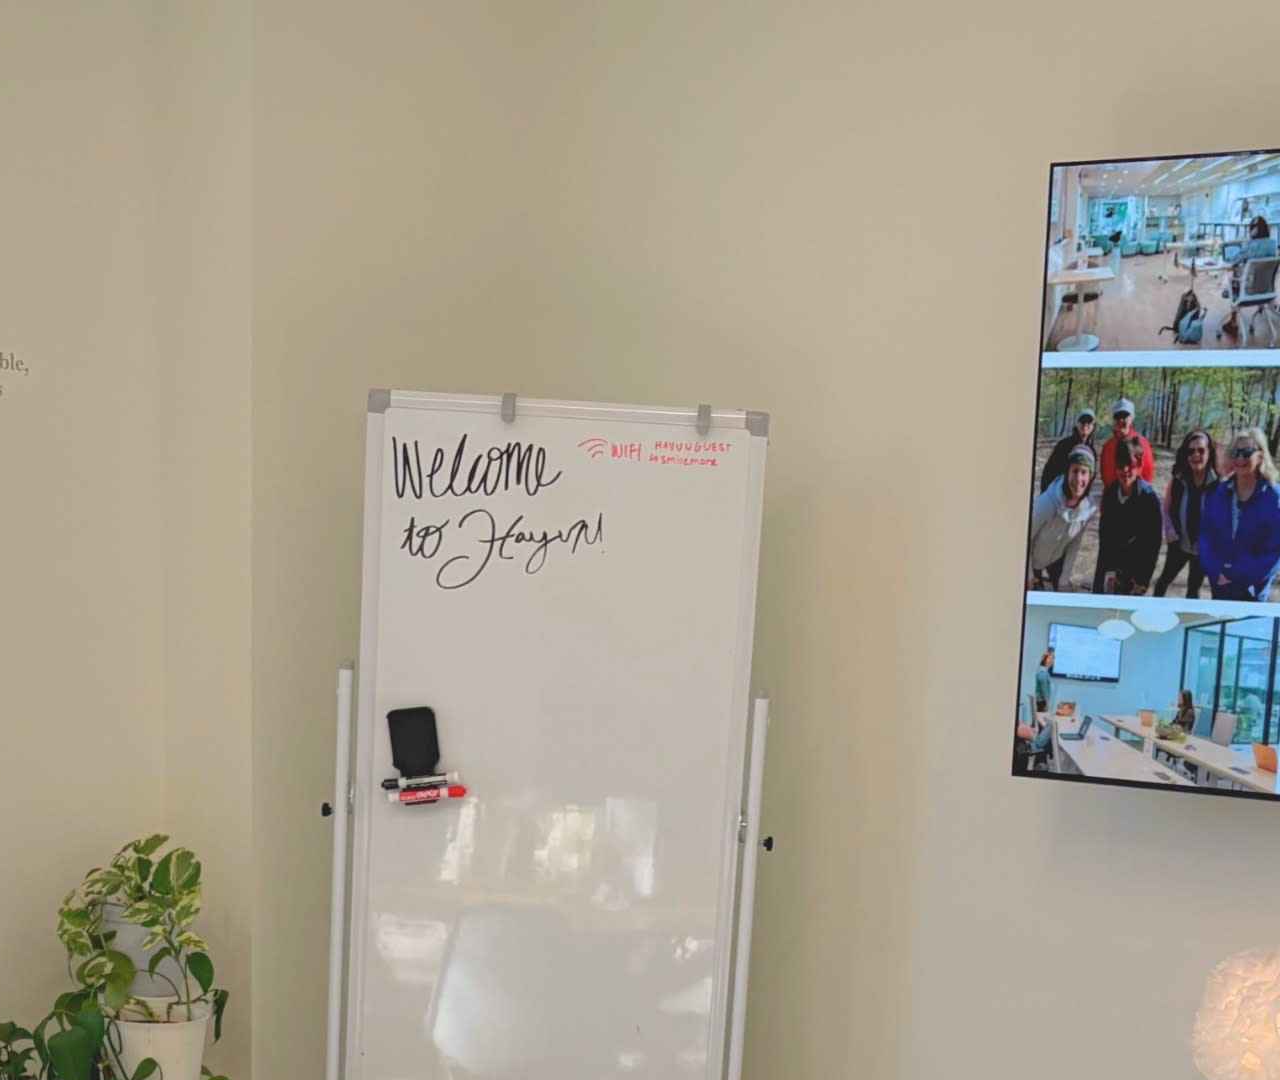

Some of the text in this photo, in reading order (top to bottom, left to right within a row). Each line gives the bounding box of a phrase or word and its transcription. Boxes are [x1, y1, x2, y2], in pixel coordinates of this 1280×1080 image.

[392, 433, 562, 499] Welcome
[611, 442, 642, 462] WIFI
[400, 516, 450, 558] to
